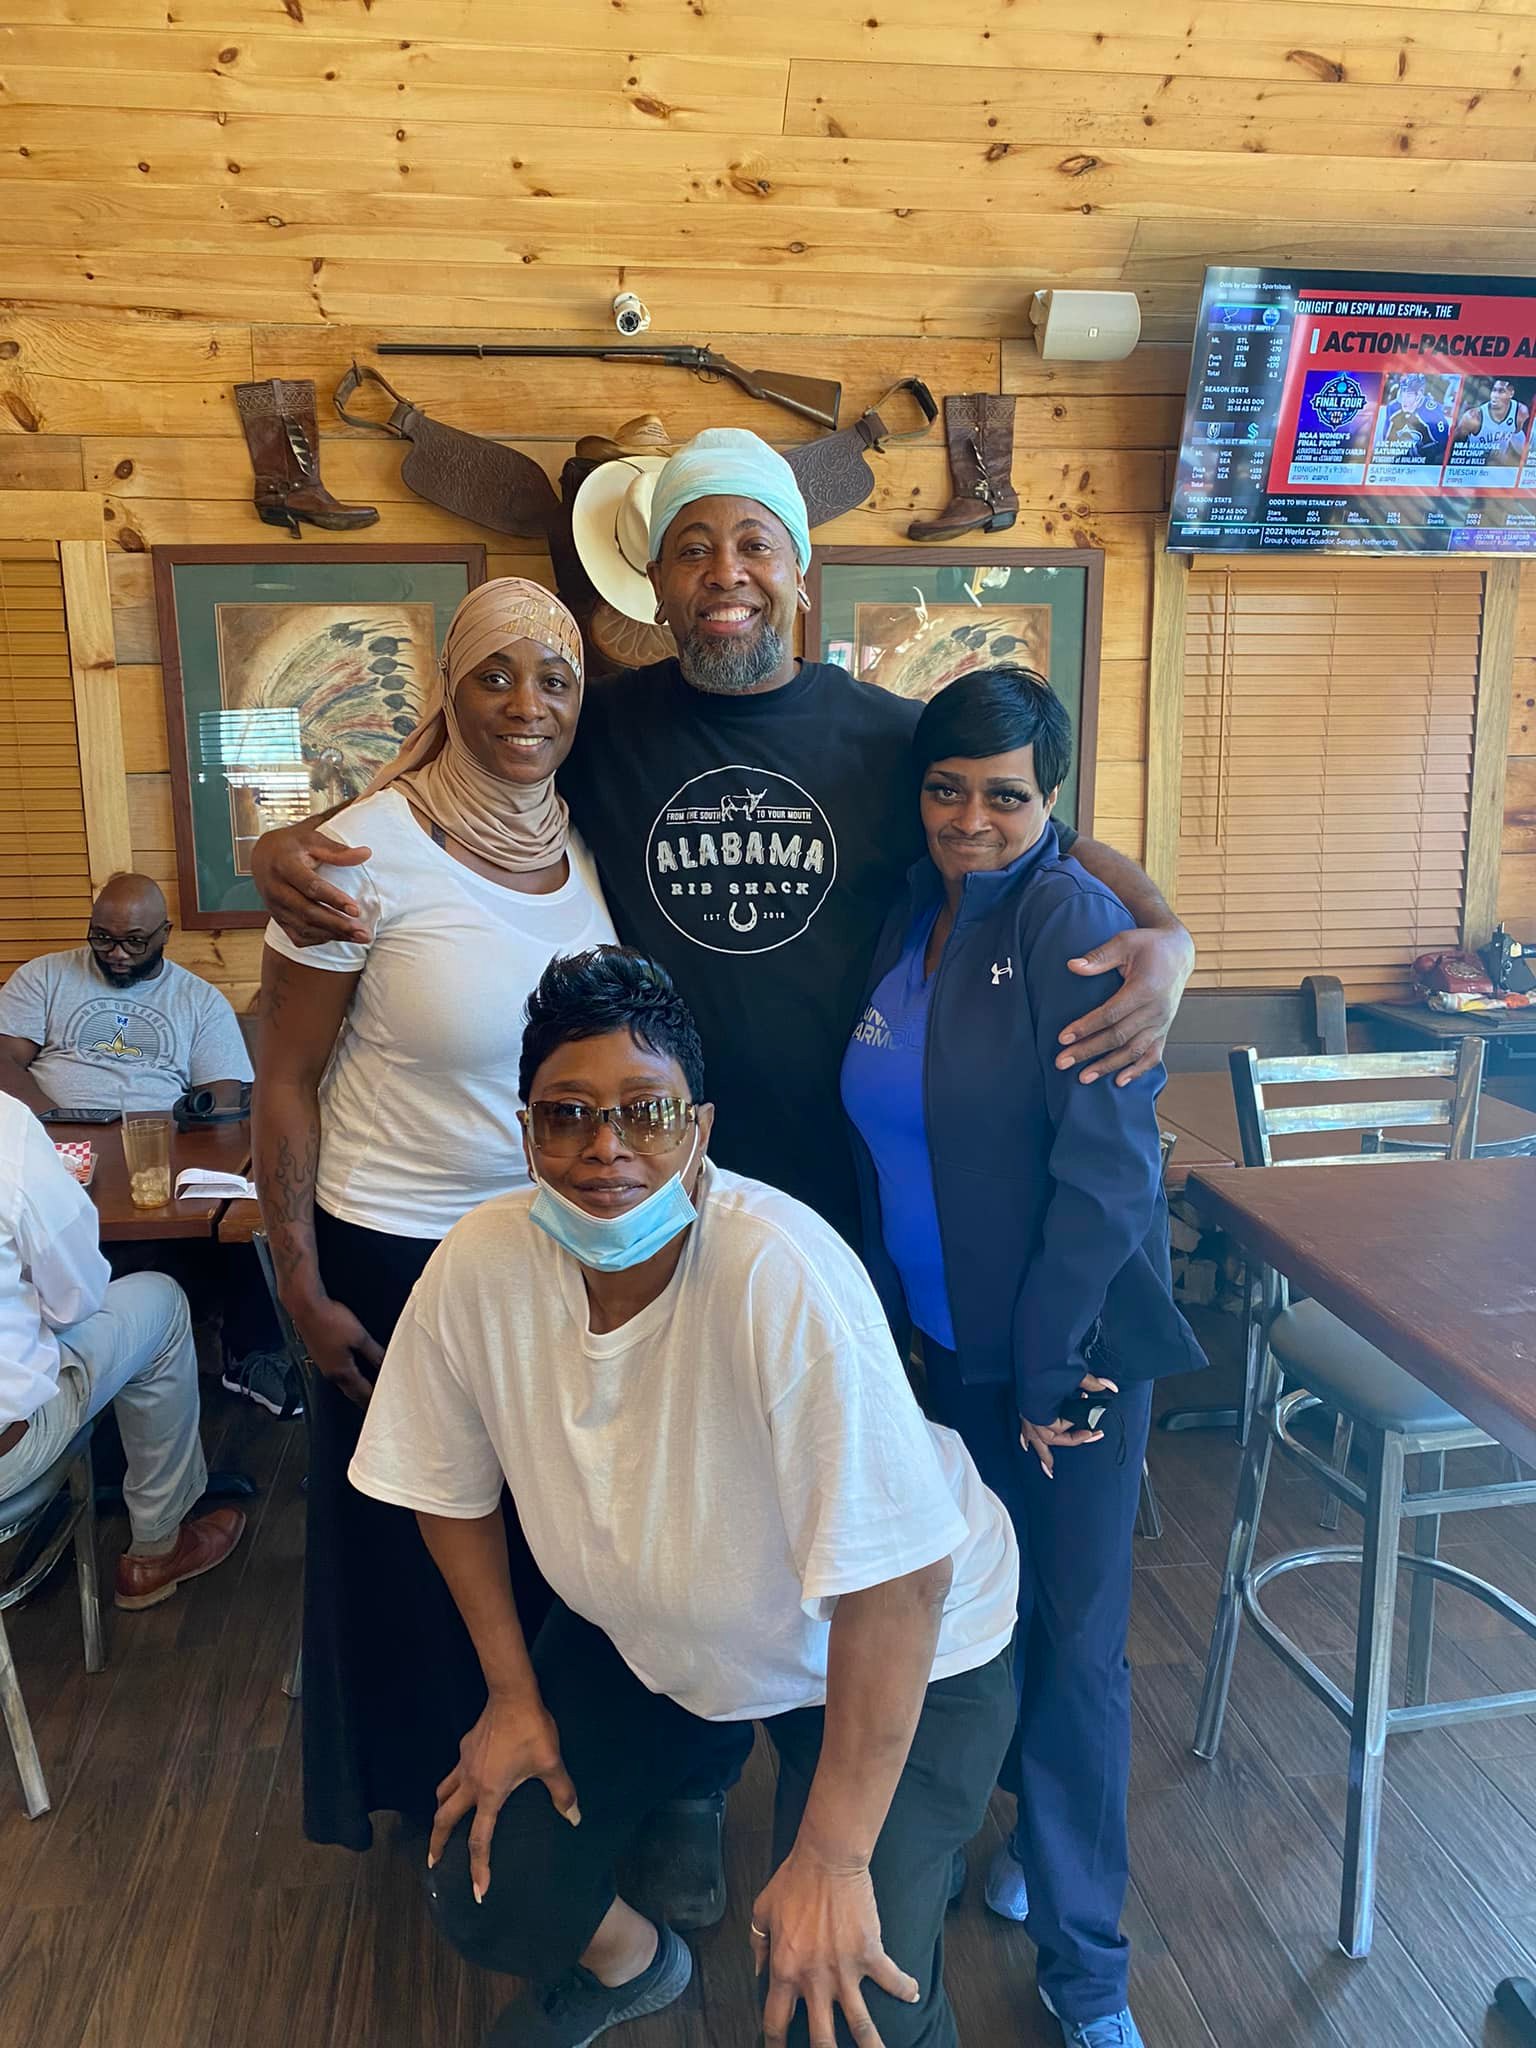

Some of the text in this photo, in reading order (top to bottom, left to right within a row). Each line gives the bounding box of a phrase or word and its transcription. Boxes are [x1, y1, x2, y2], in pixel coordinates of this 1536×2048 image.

[1293, 300, 1454, 318] TONIGHT ON ESPN AND ESPN+, THE
[1322, 330, 1511, 358] ACTION-PACKED
[1204, 385, 1249, 394] SEASON STATS
[1315, 396, 1363, 408] FINAL FOUR
[1298, 431, 1351, 440] NCAA WOMEN'S
[1297, 439, 1318, 447] FINAL
[1373, 447, 1410, 455] SATURDAY
[1452, 449, 1485, 457] MATCHUP
[1448, 468, 1478, 476] TUESDAY
[1214, 496, 1232, 504] STATS
[1264, 527, 1340, 537] 2022 World Cup Draw
[1263, 537, 1283, 545] Group
[1309, 538, 1336, 546] Ecuador,
[1336, 538, 1361, 546] Senegal,
[666, 808, 813, 822] FROM THE SOUTH TO YOUR MOUTH
[656, 830, 826, 875] ALABAMA
[671, 881, 810, 896] RIB SHACK
[703, 913, 727, 922] EST.
[82, 1001, 108, 1017] NEW
[114, 1002, 168, 1031] ORLEANS
